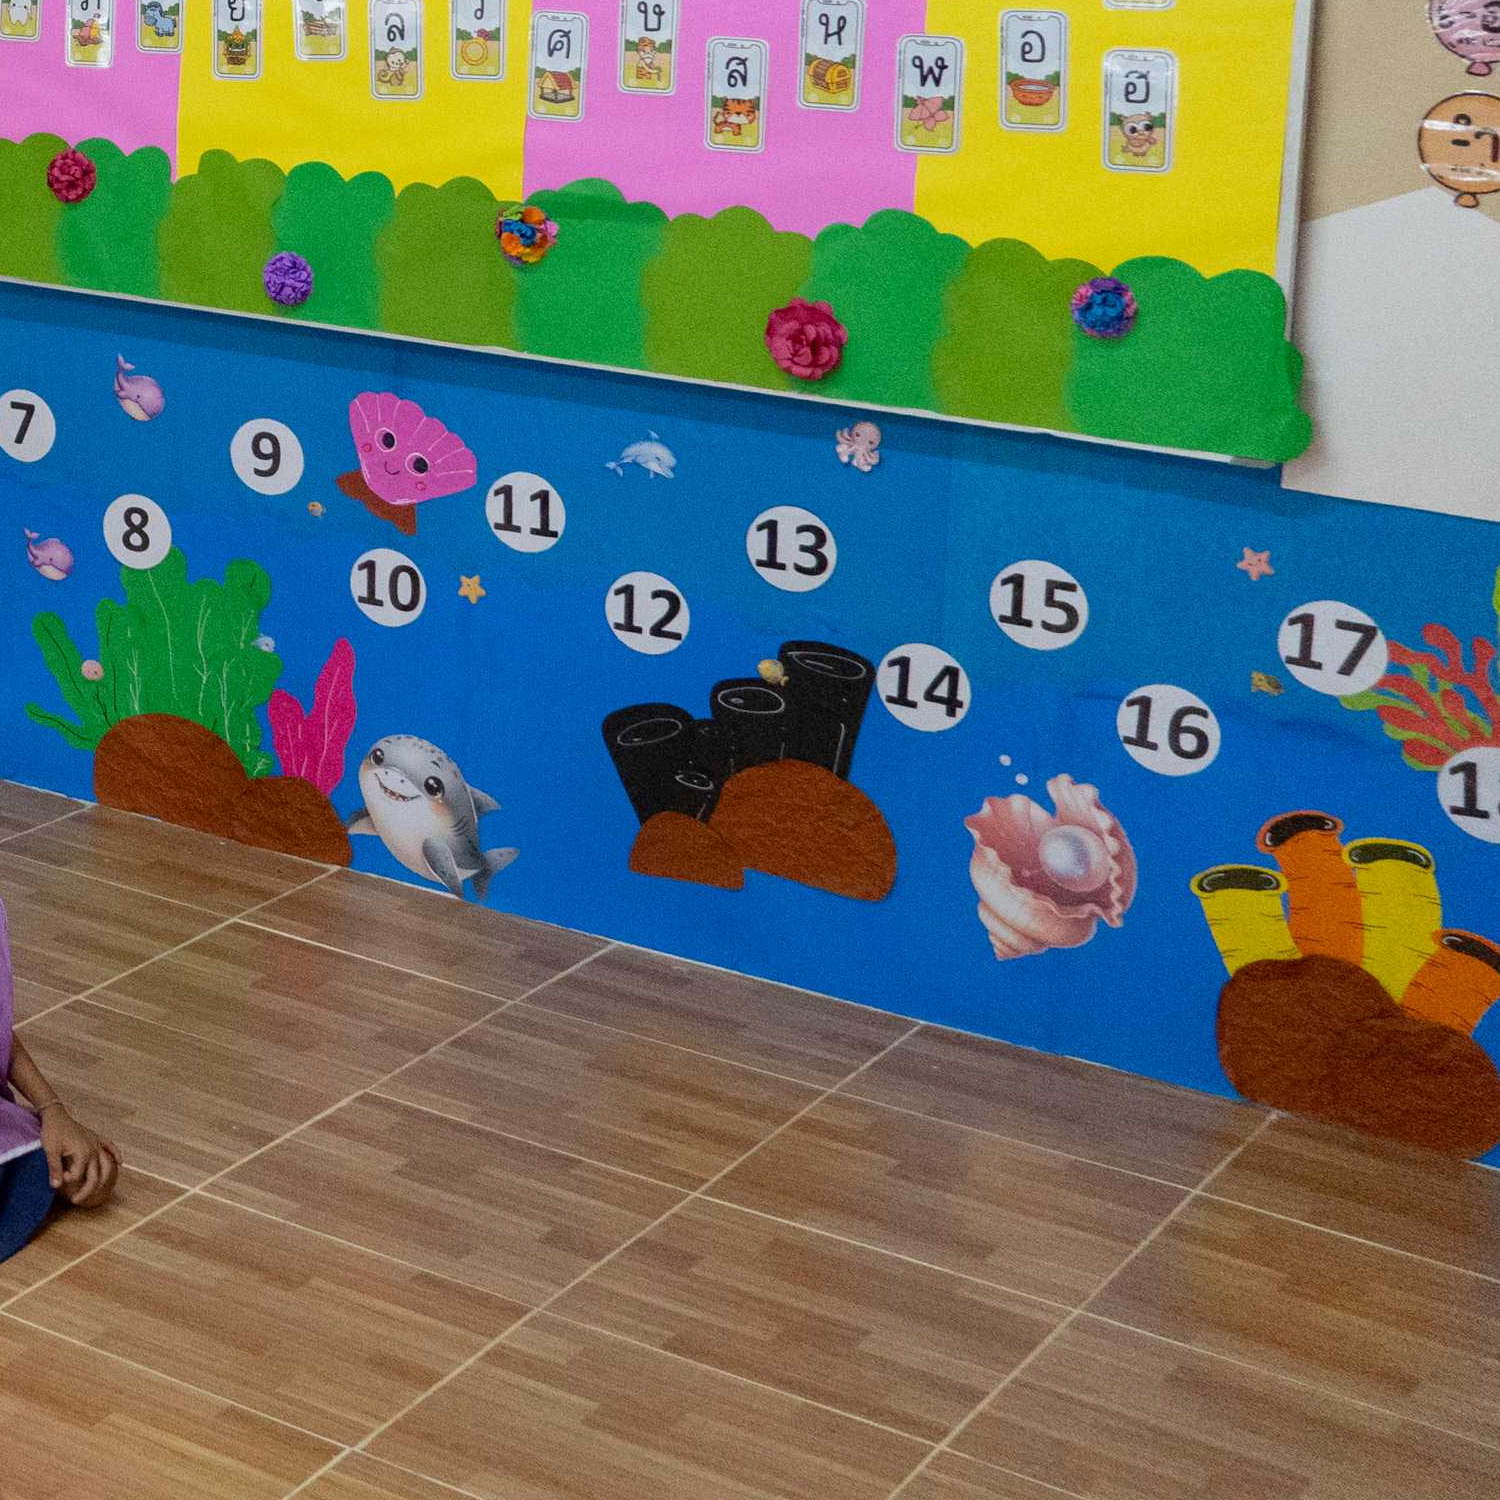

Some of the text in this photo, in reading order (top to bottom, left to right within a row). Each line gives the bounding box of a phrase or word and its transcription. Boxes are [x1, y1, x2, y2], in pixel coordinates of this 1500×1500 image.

[385, 13, 405, 42] ล
[638, 1, 665, 31] ษ
[819, 13, 846, 45] ห
[548, 30, 571, 58] ศ
[1021, 31, 1045, 62] อ
[726, 57, 748, 87] ส
[1124, 70, 1150, 103] ฮ
[11, 402, 34, 444] 7
[252, 432, 280, 477] 9
[123, 507, 149, 552] 8
[494, 485, 558, 538] 11
[756, 520, 828, 576] 13
[358, 560, 420, 612] 10
[999, 574, 1079, 633] 15
[614, 584, 682, 640] 12
[1286, 614, 1377, 676] 17
[886, 656, 963, 717] 14
[1124, 696, 1208, 759] 16
[1450, 762, 1500, 819] 1
